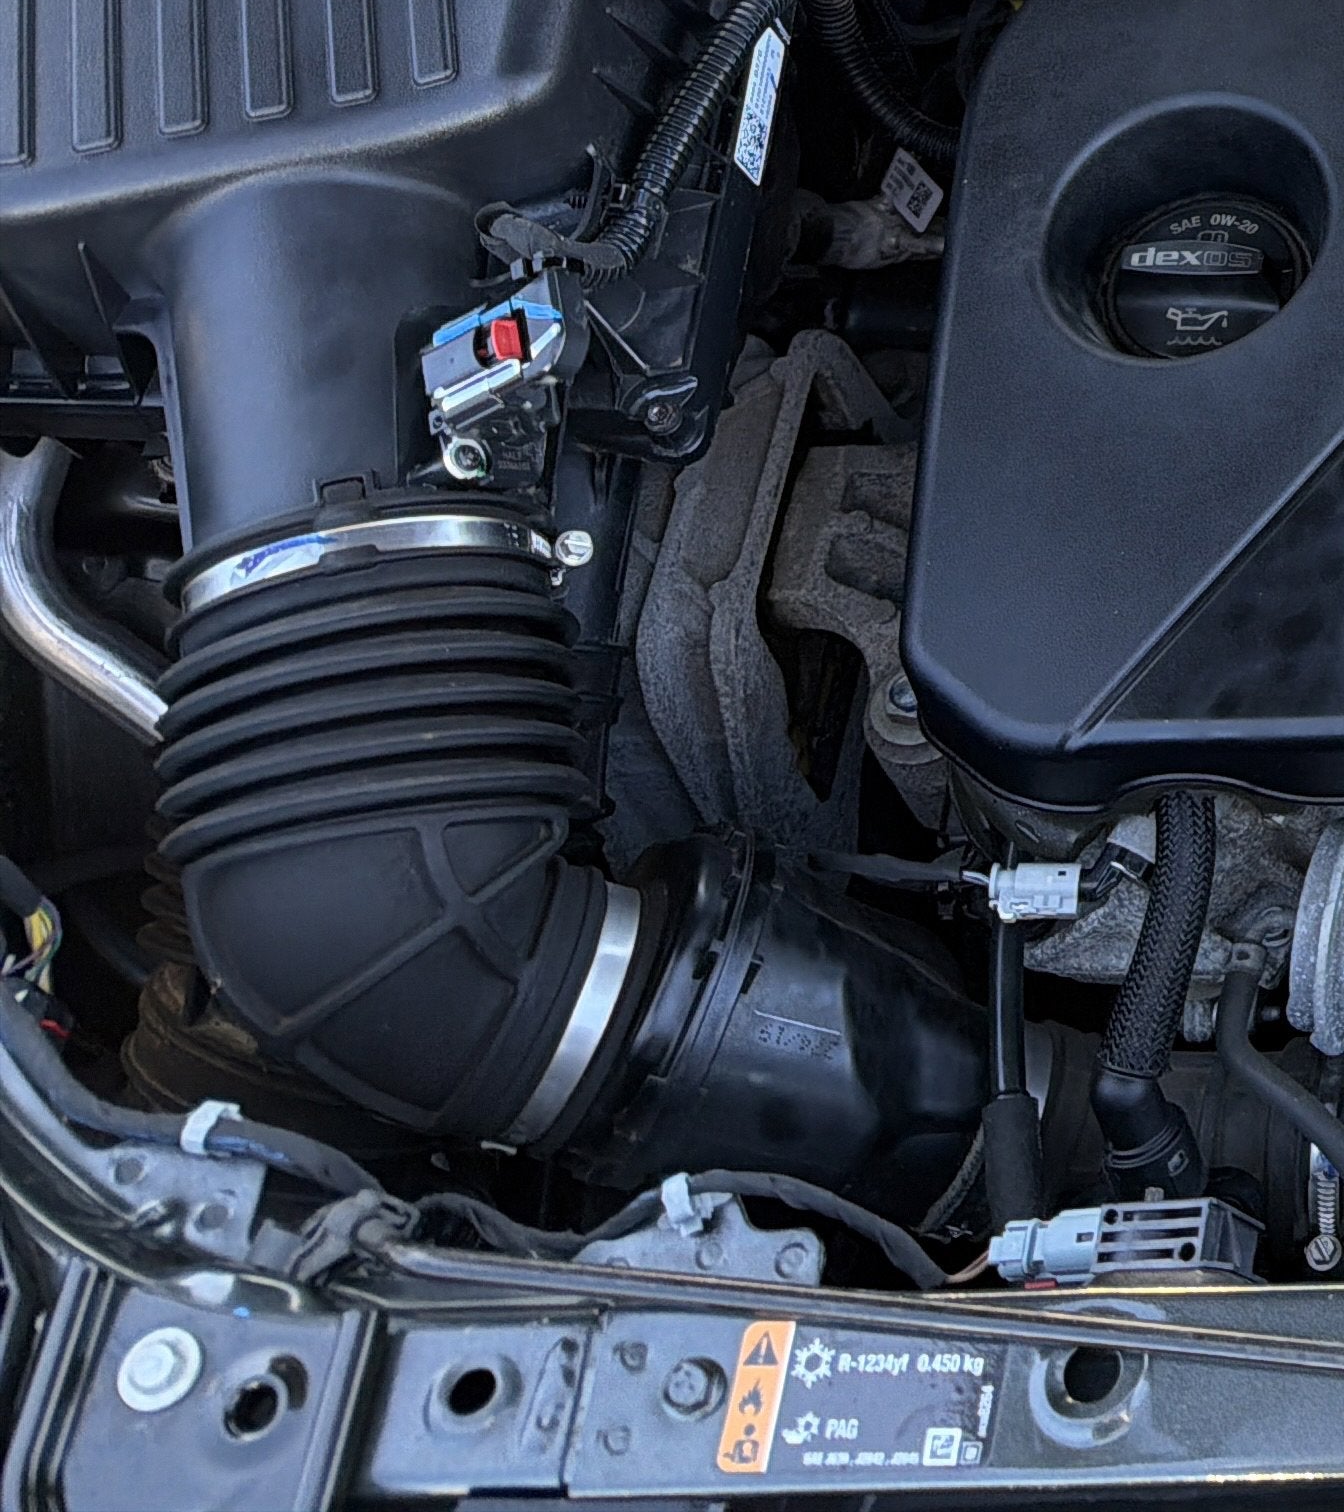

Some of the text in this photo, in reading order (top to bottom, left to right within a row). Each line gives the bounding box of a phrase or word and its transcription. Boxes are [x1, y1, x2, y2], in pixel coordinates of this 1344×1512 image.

[1169, 213, 1259, 235] SAE 0W-20
[1131, 246, 1252, 267] dexos
[837, 1354, 985, 1376] R-1234yf 0.450 kg
[824, 1418, 859, 1439] PAG
